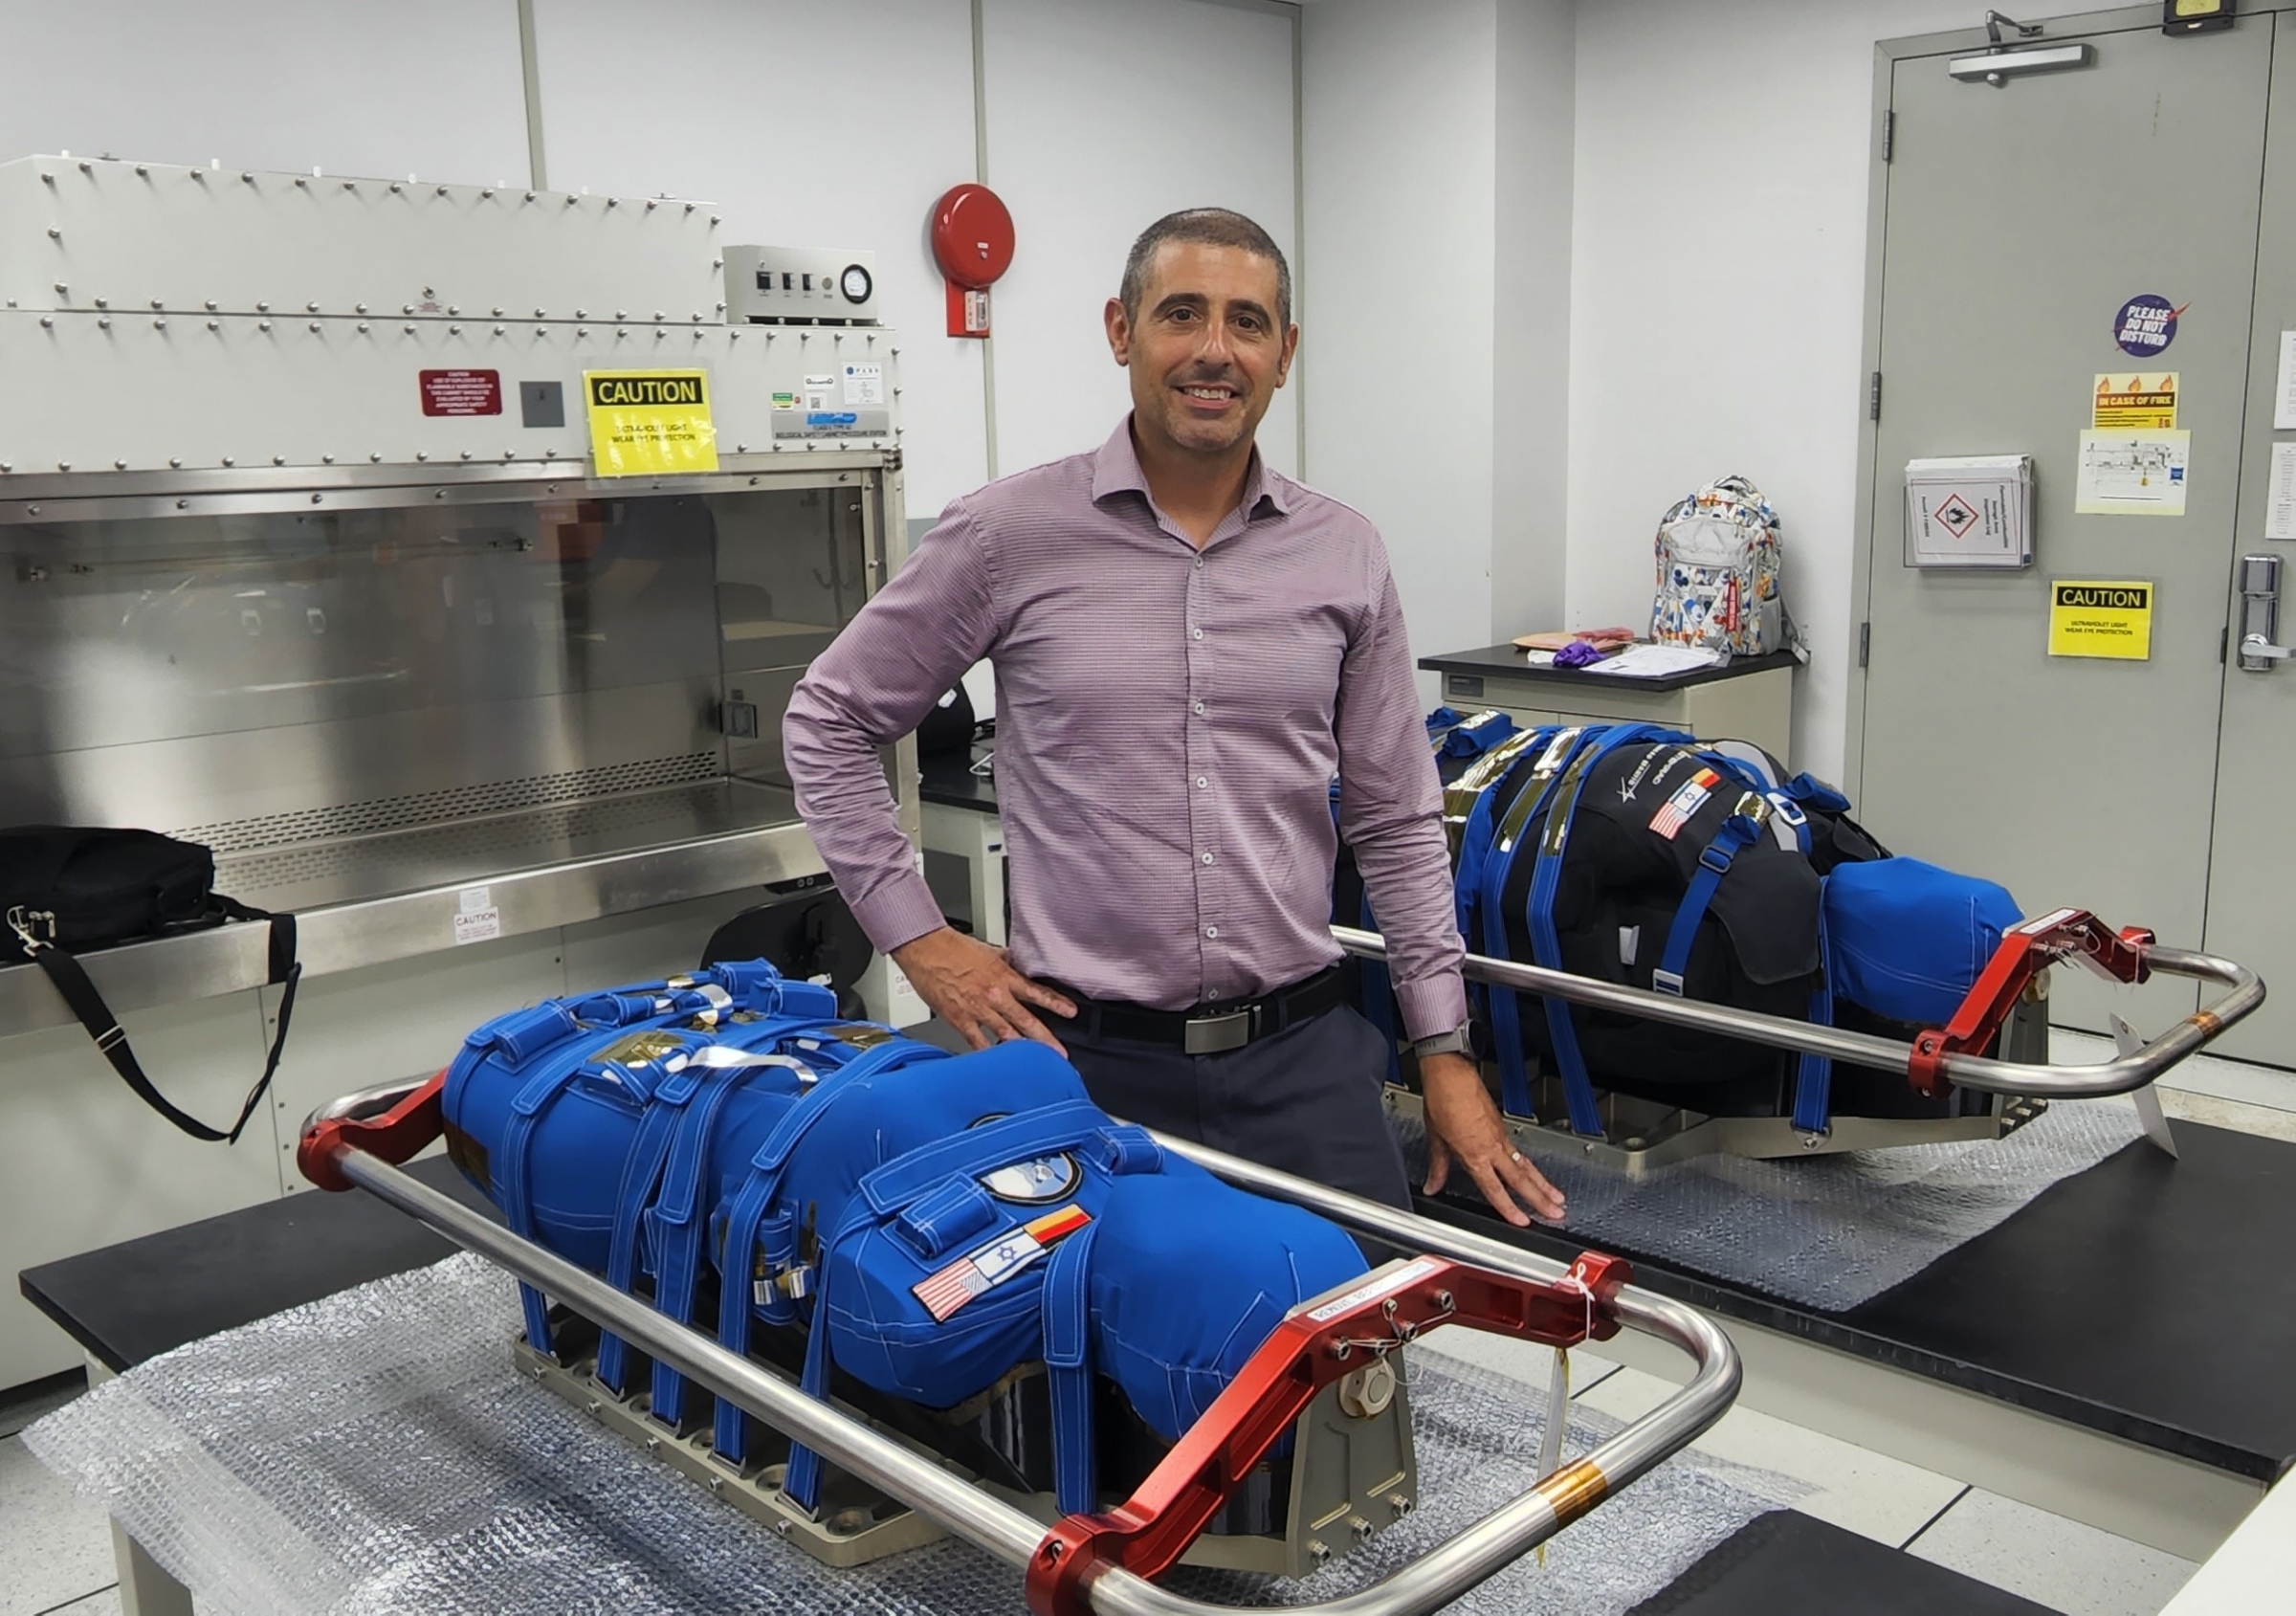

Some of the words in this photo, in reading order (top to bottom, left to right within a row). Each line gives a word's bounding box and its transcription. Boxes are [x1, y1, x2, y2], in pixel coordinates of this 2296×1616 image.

[2127, 305, 2171, 322] PLEASE
[2125, 318, 2142, 331] DO
[2142, 320, 2167, 334] NOT
[2119, 329, 2168, 346] DISTURB
[598, 381, 696, 403] CAUTION
[2098, 397, 2109, 406] IN
[2110, 397, 2135, 406] CASE
[2136, 396, 2150, 405] OF
[2150, 395, 2172, 405] FIRE
[2063, 589, 2141, 607] CAUTION
[456, 912, 497, 926] CAUTION
